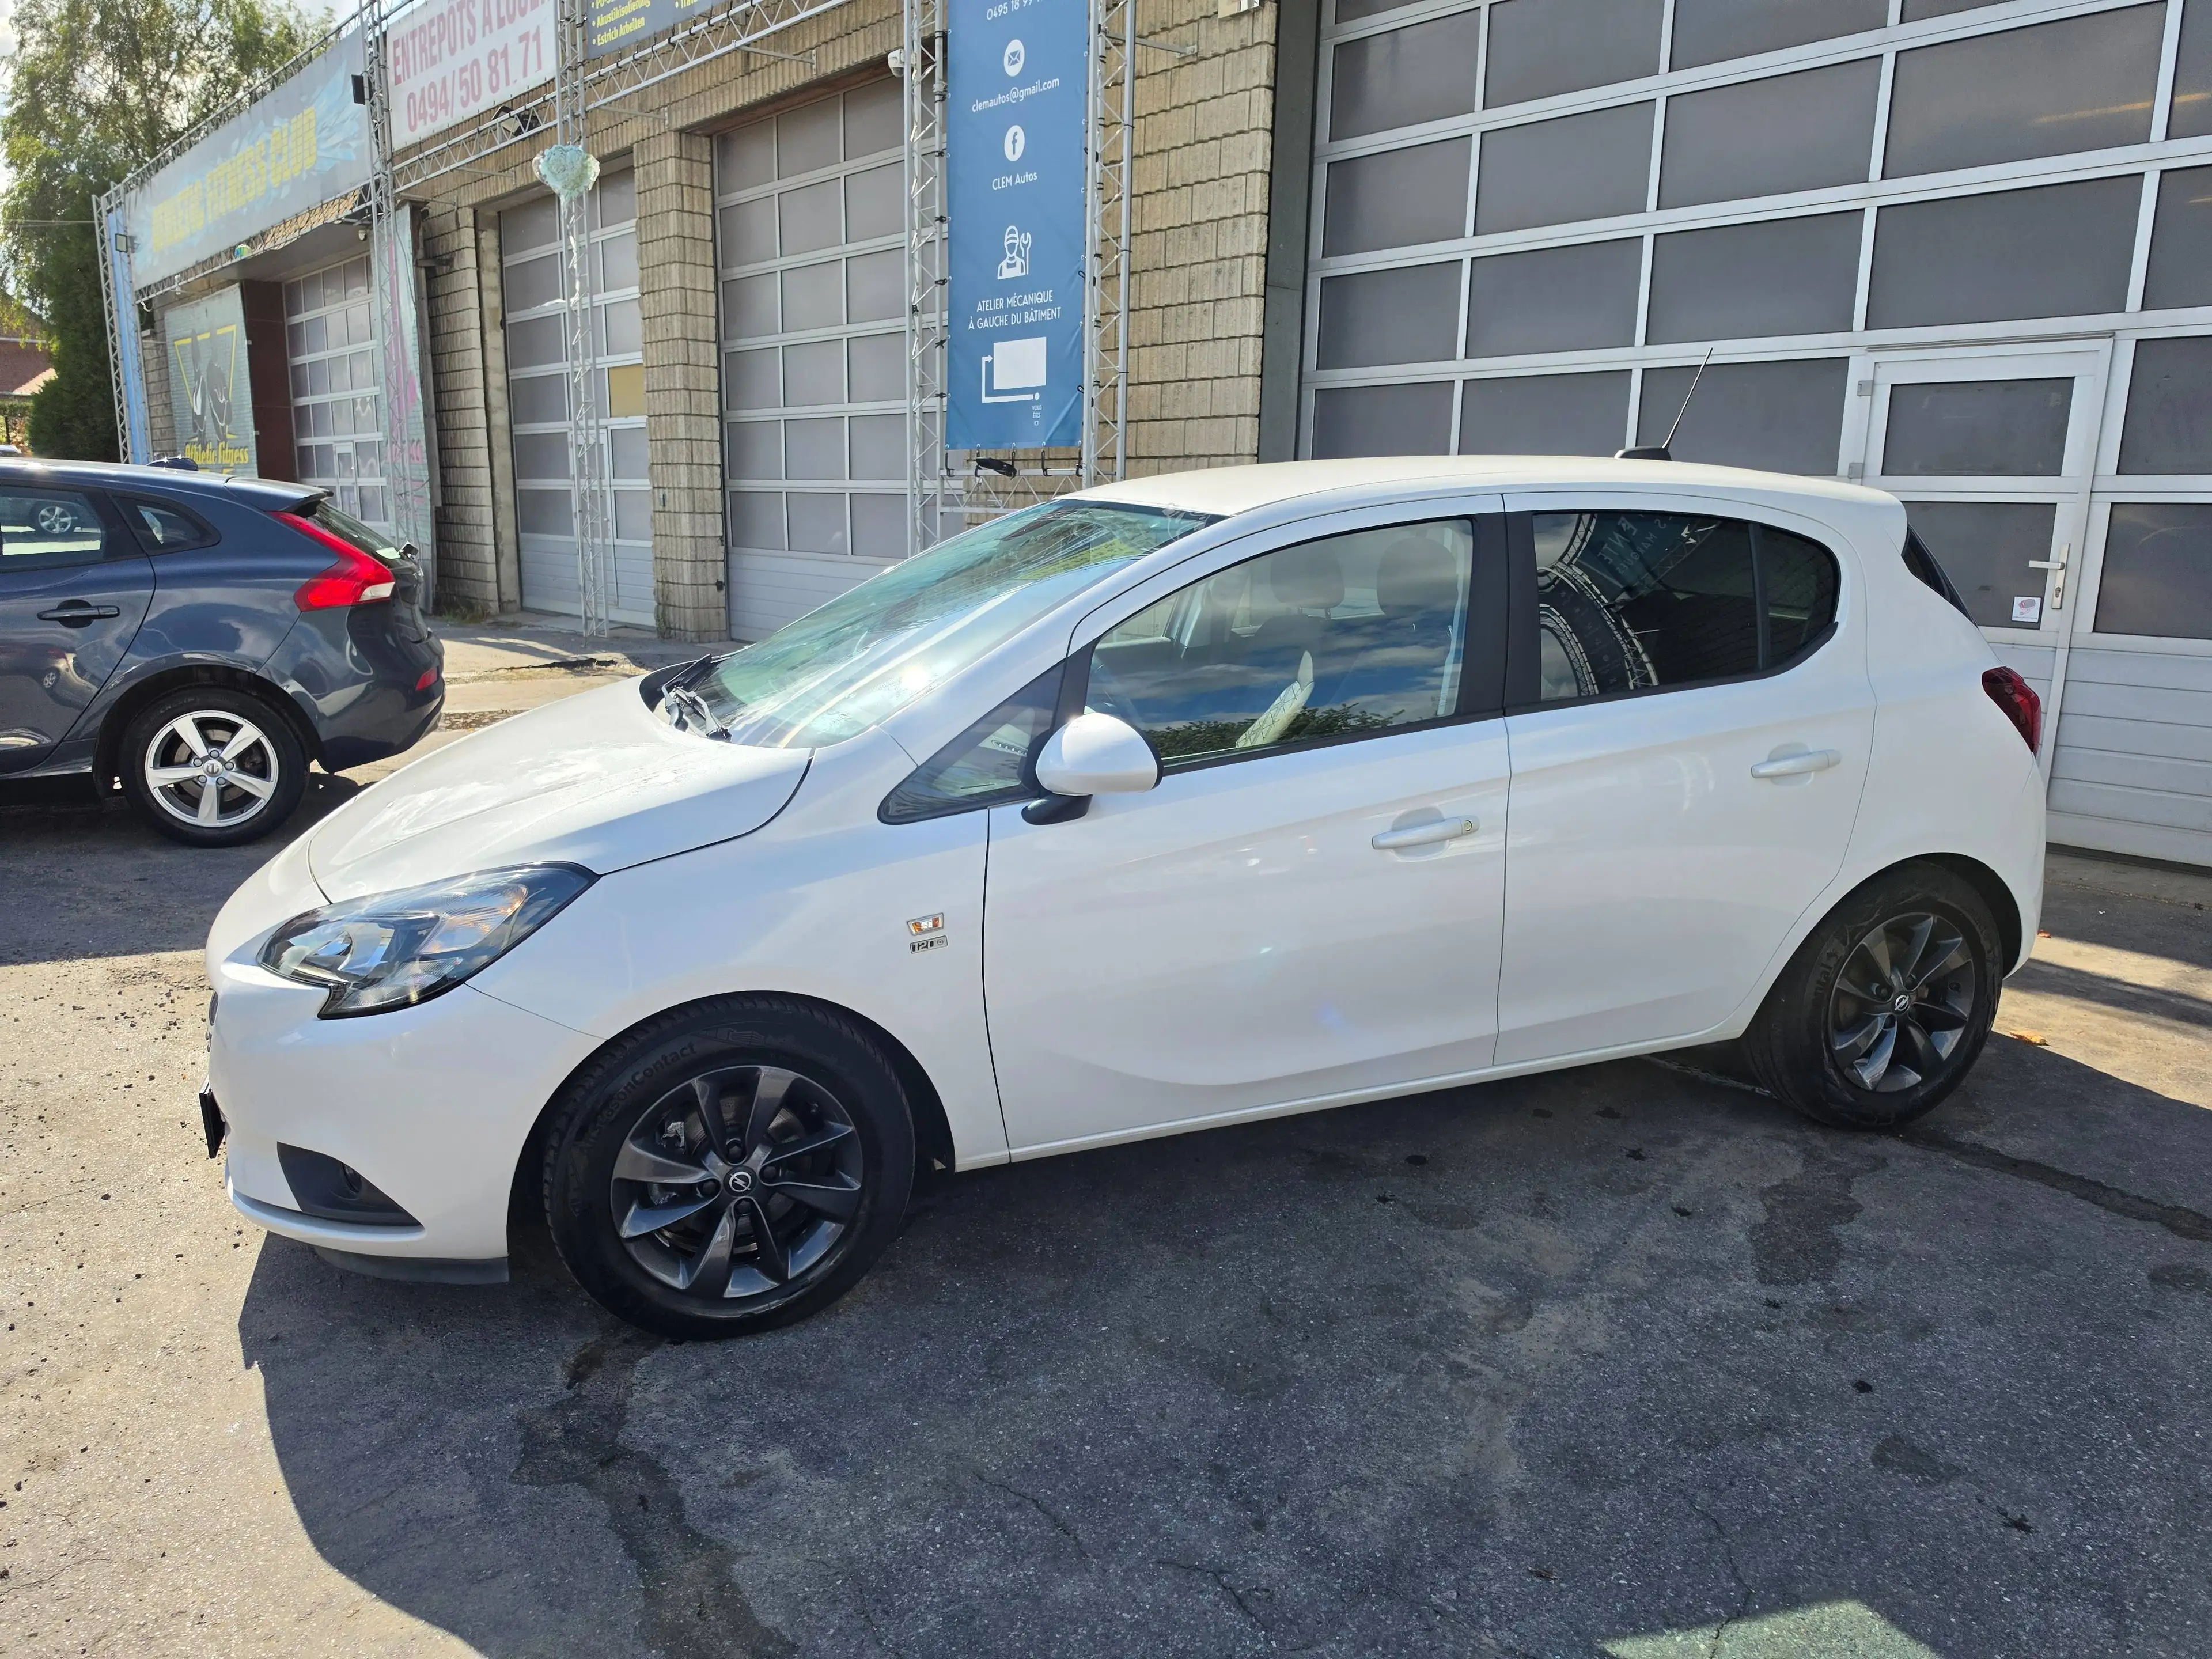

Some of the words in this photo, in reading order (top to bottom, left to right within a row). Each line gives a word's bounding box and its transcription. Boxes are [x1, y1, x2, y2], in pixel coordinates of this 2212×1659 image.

[987, 2, 1008, 20] 0495
[597, 26, 618, 46] Estrich
[619, 16, 645, 37] Arbeiten
[972, 78, 1059, 112] clemautos@gmail.com
[992, 176, 1012, 191] CLEM
[1015, 172, 1037, 185] Autos
[976, 297, 1004, 312] ATELIER
[1006, 290, 1053, 308] MÉCANIQUE
[968, 316, 975, 330] À
[977, 314, 1009, 329] GAUCHE
[1011, 313, 1022, 324] DU
[1024, 307, 1062, 323] BÂTIMENT
[185, 442, 217, 465] Athletic
[218, 440, 249, 467] Fitness
